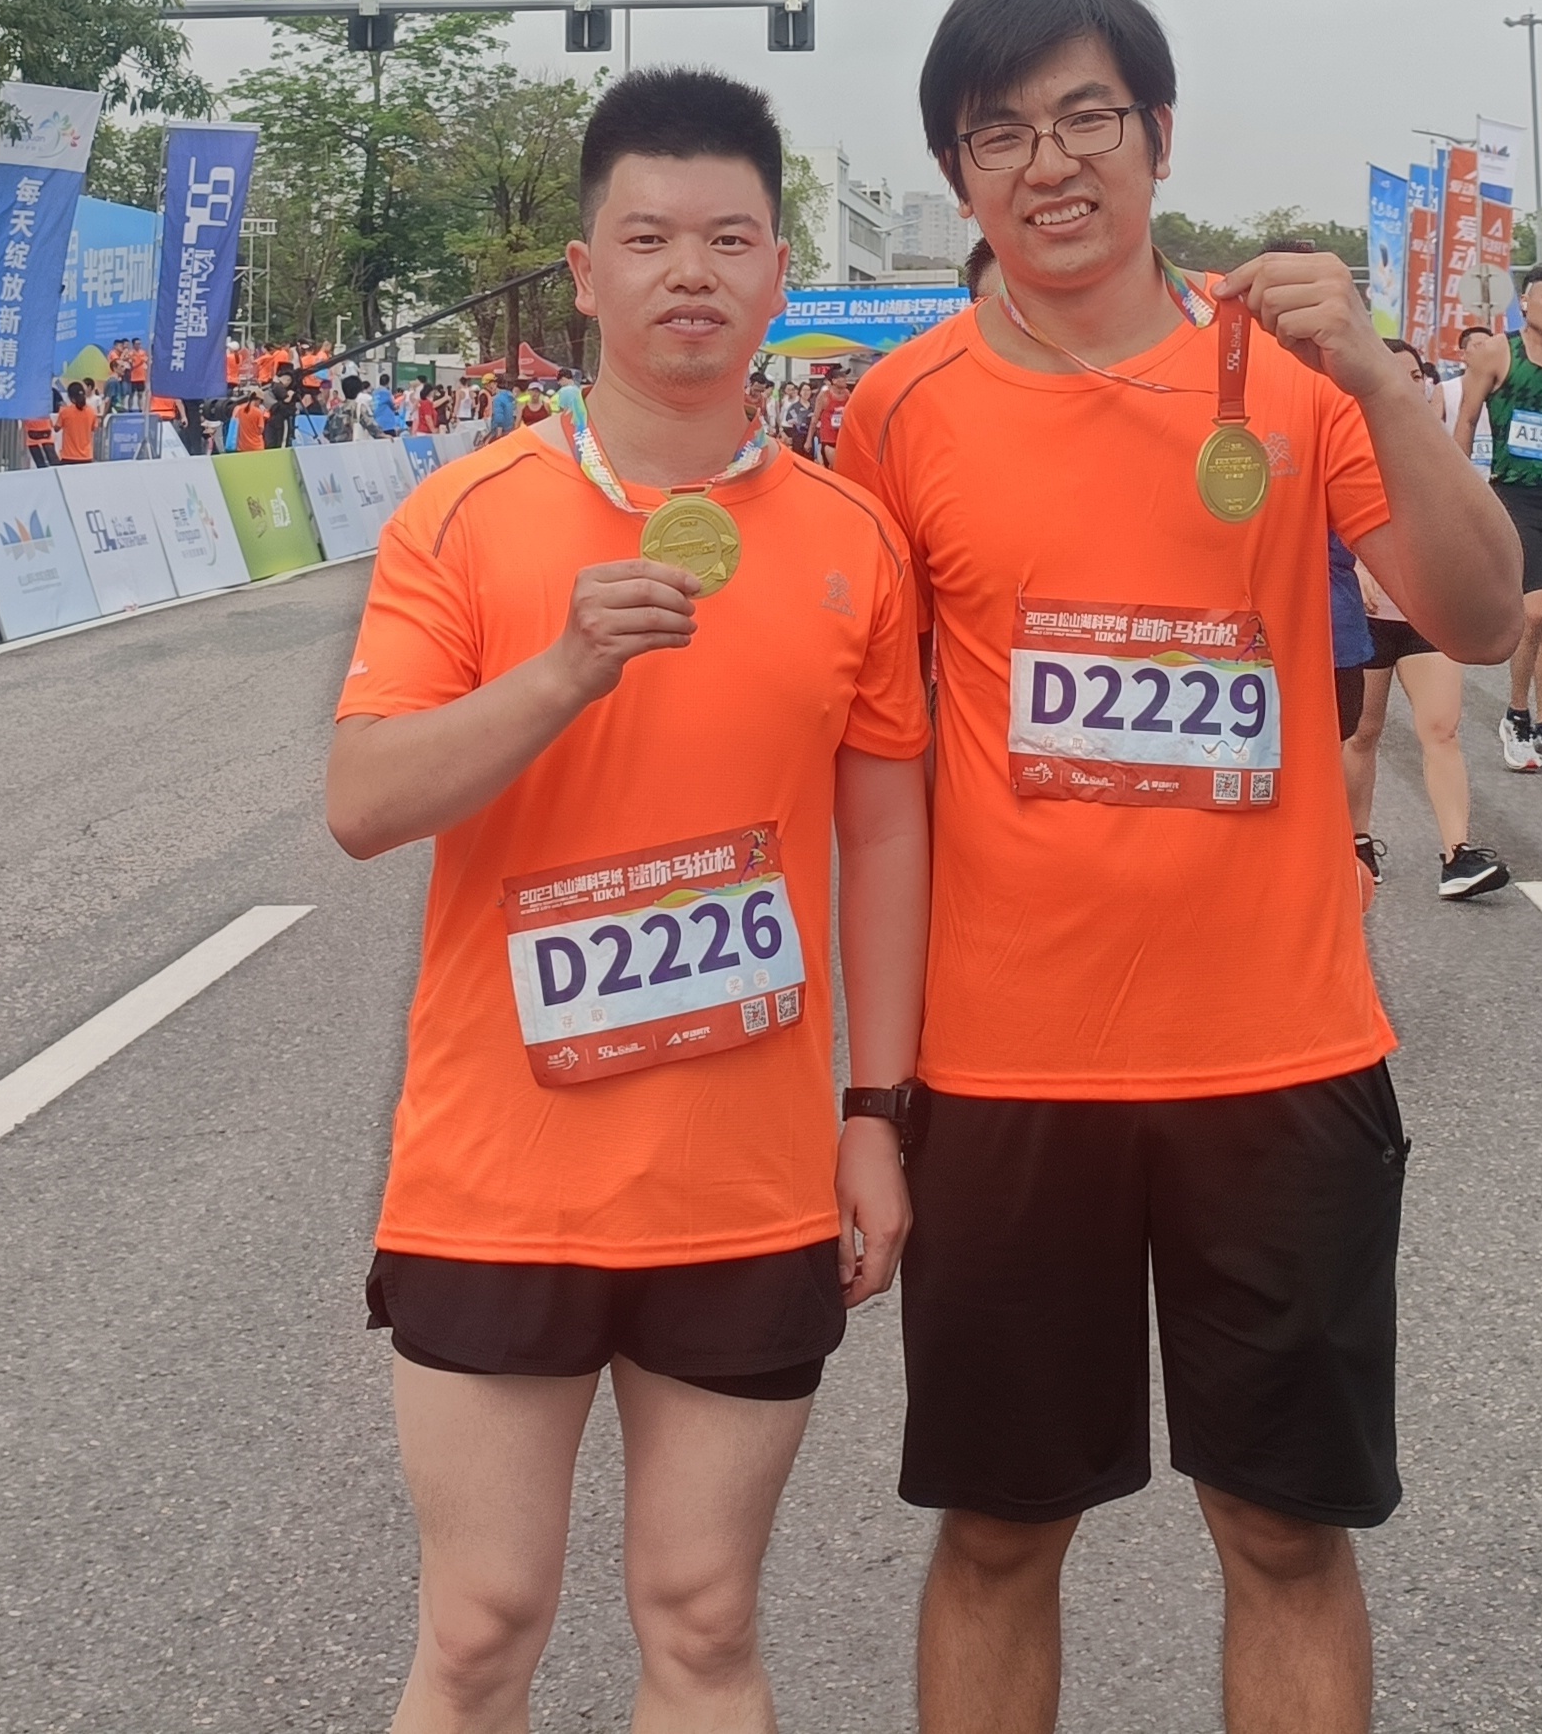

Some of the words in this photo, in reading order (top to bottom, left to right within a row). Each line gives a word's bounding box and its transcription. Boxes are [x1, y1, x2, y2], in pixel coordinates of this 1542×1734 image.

[786, 301, 846, 317] 2023
[1094, 631, 1127, 644] 10KM
[1130, 617, 1238, 647] 迷你马拉松
[1030, 660, 1267, 739] D2229
[628, 844, 736, 892] 迷你马拉松
[592, 885, 626, 903] 10KM
[534, 890, 783, 1006] D2226
